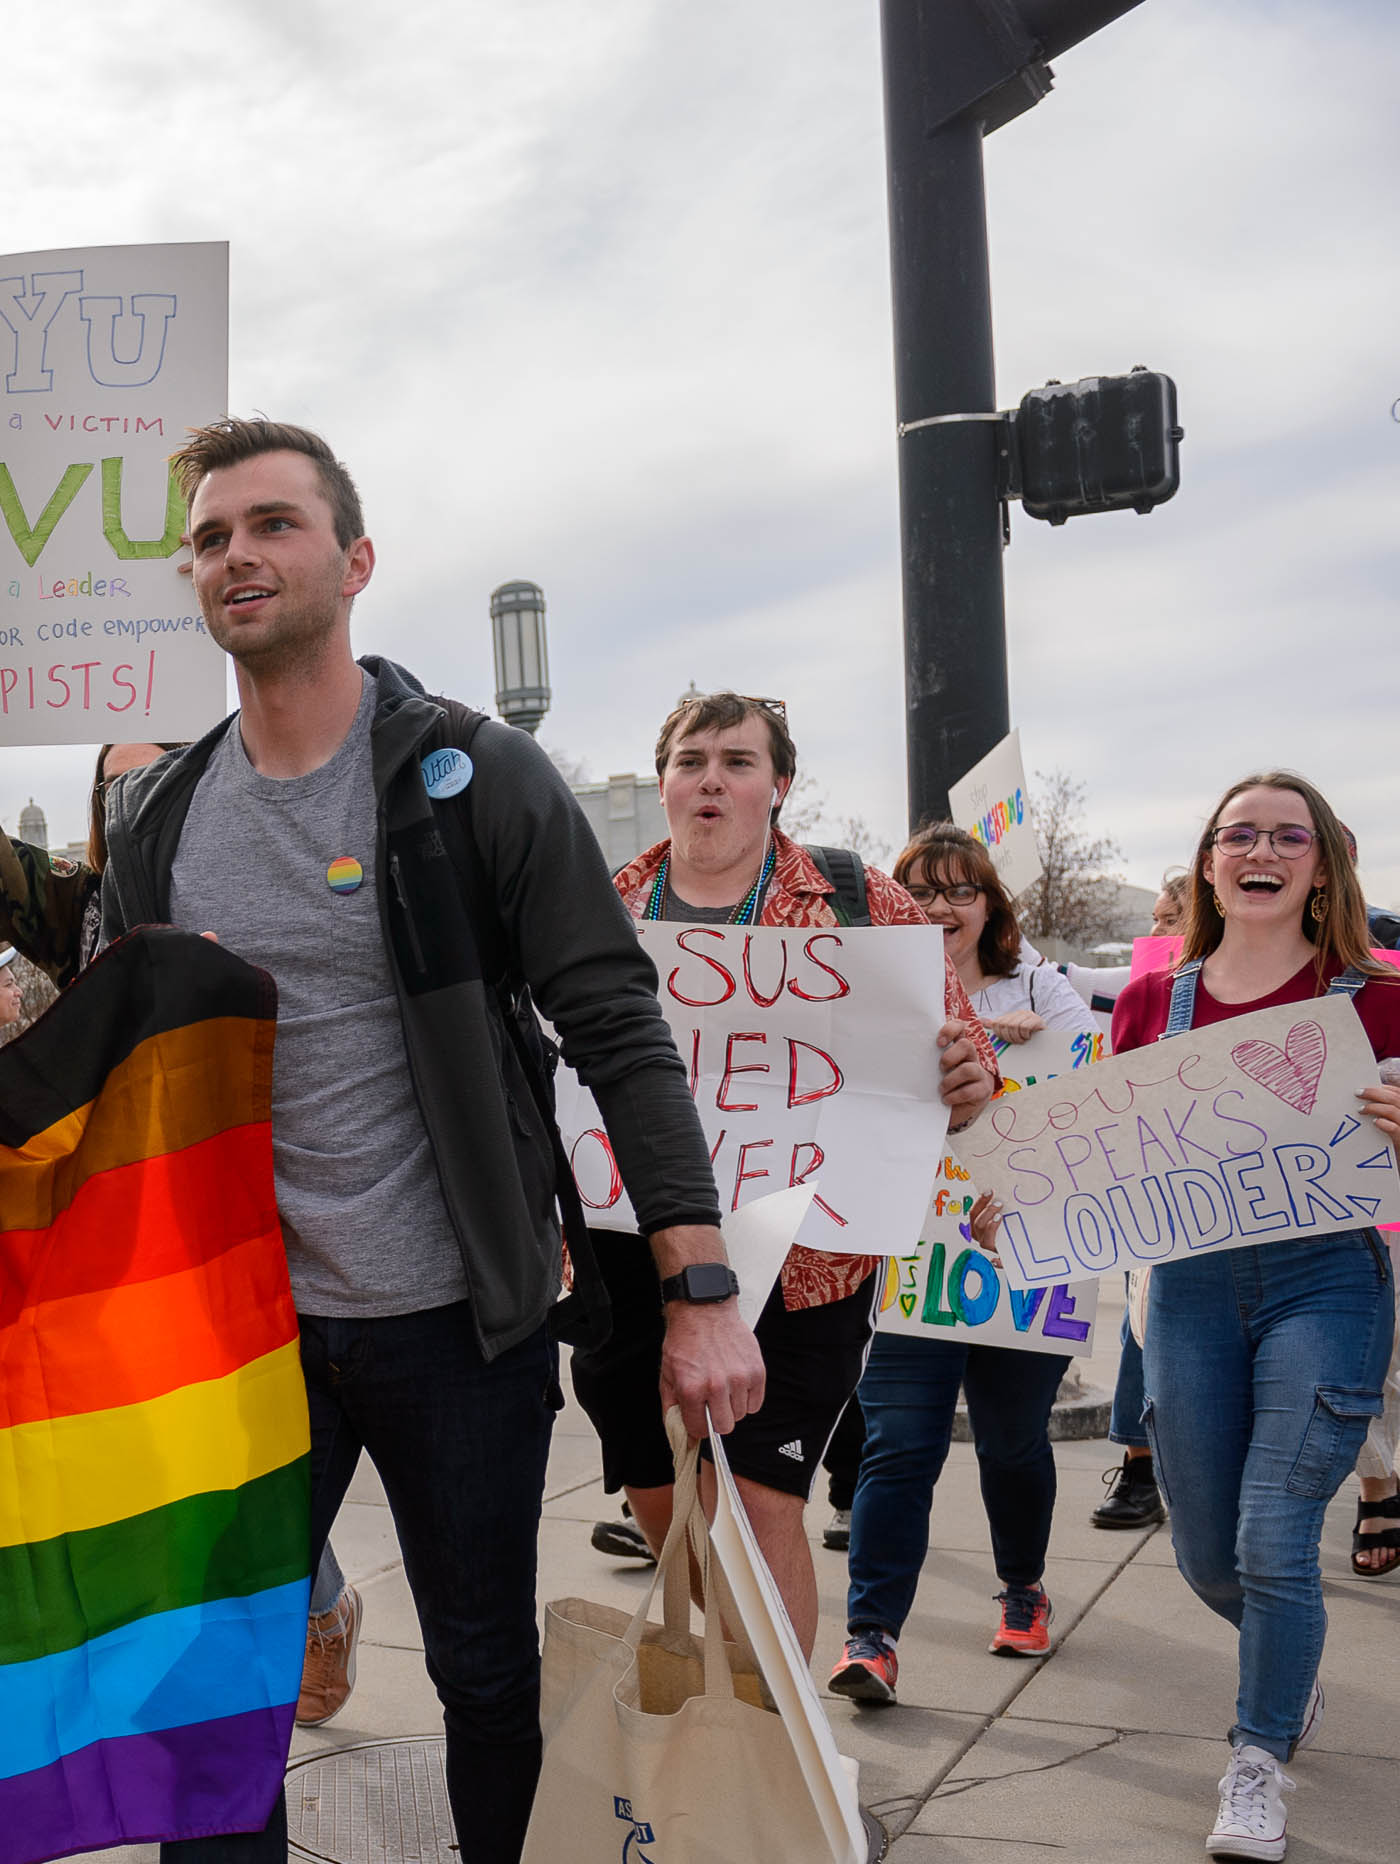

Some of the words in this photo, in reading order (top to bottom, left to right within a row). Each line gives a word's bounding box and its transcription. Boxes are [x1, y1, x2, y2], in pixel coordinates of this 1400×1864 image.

[8, 412, 22, 430] a
[44, 413, 164, 437] VICTIM
[7, 580, 21, 599] a
[422, 751, 465, 788] Utah
[638, 927, 851, 1008] SUS
[689, 1028, 845, 1112] IED
[1007, 1090, 1268, 1206] SPEAKS
[1002, 1142, 1353, 1281] LOUDER
[921, 1242, 1092, 1342] LOVE
